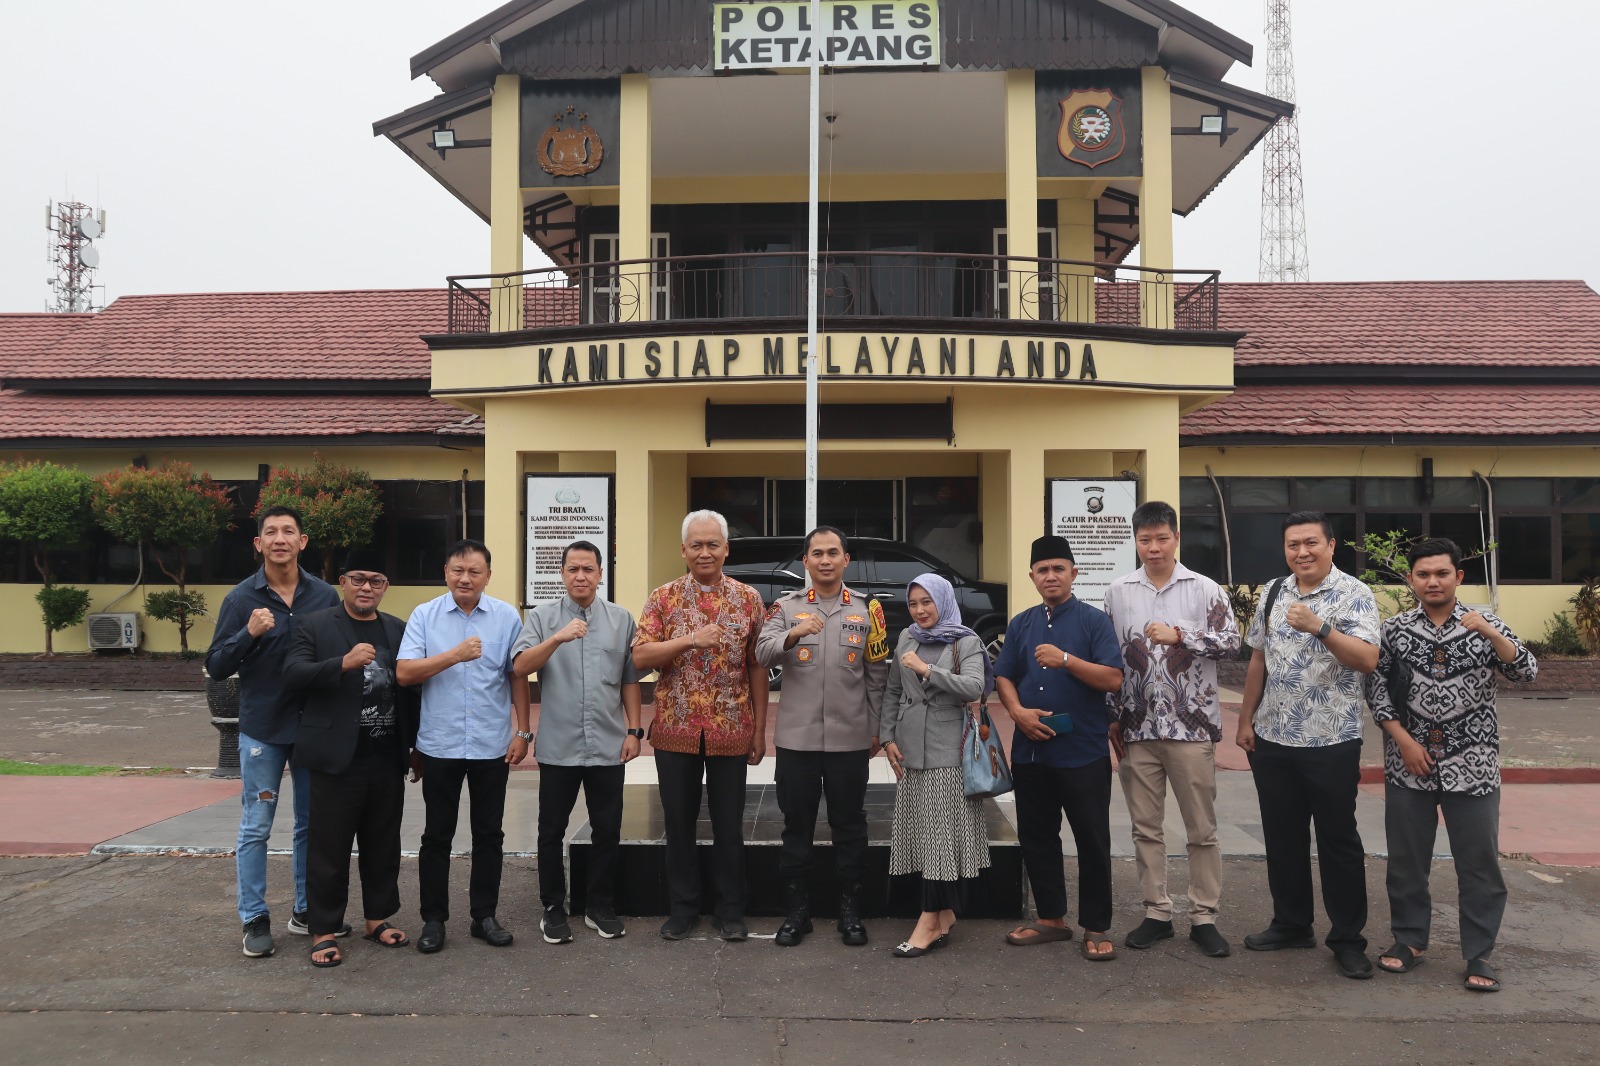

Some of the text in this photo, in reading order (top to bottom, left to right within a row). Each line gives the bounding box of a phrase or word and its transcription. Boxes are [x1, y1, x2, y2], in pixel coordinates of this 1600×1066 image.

[721, 3, 932, 33] POLRES
[721, 34, 932, 64] KETAPANG
[538, 335, 1098, 383] KAMI SIAP MELAYANI ANDA
[548, 506, 587, 514] TRI BRATA
[124, 622, 133, 644] AUX
[842, 623, 868, 633] POLRI
